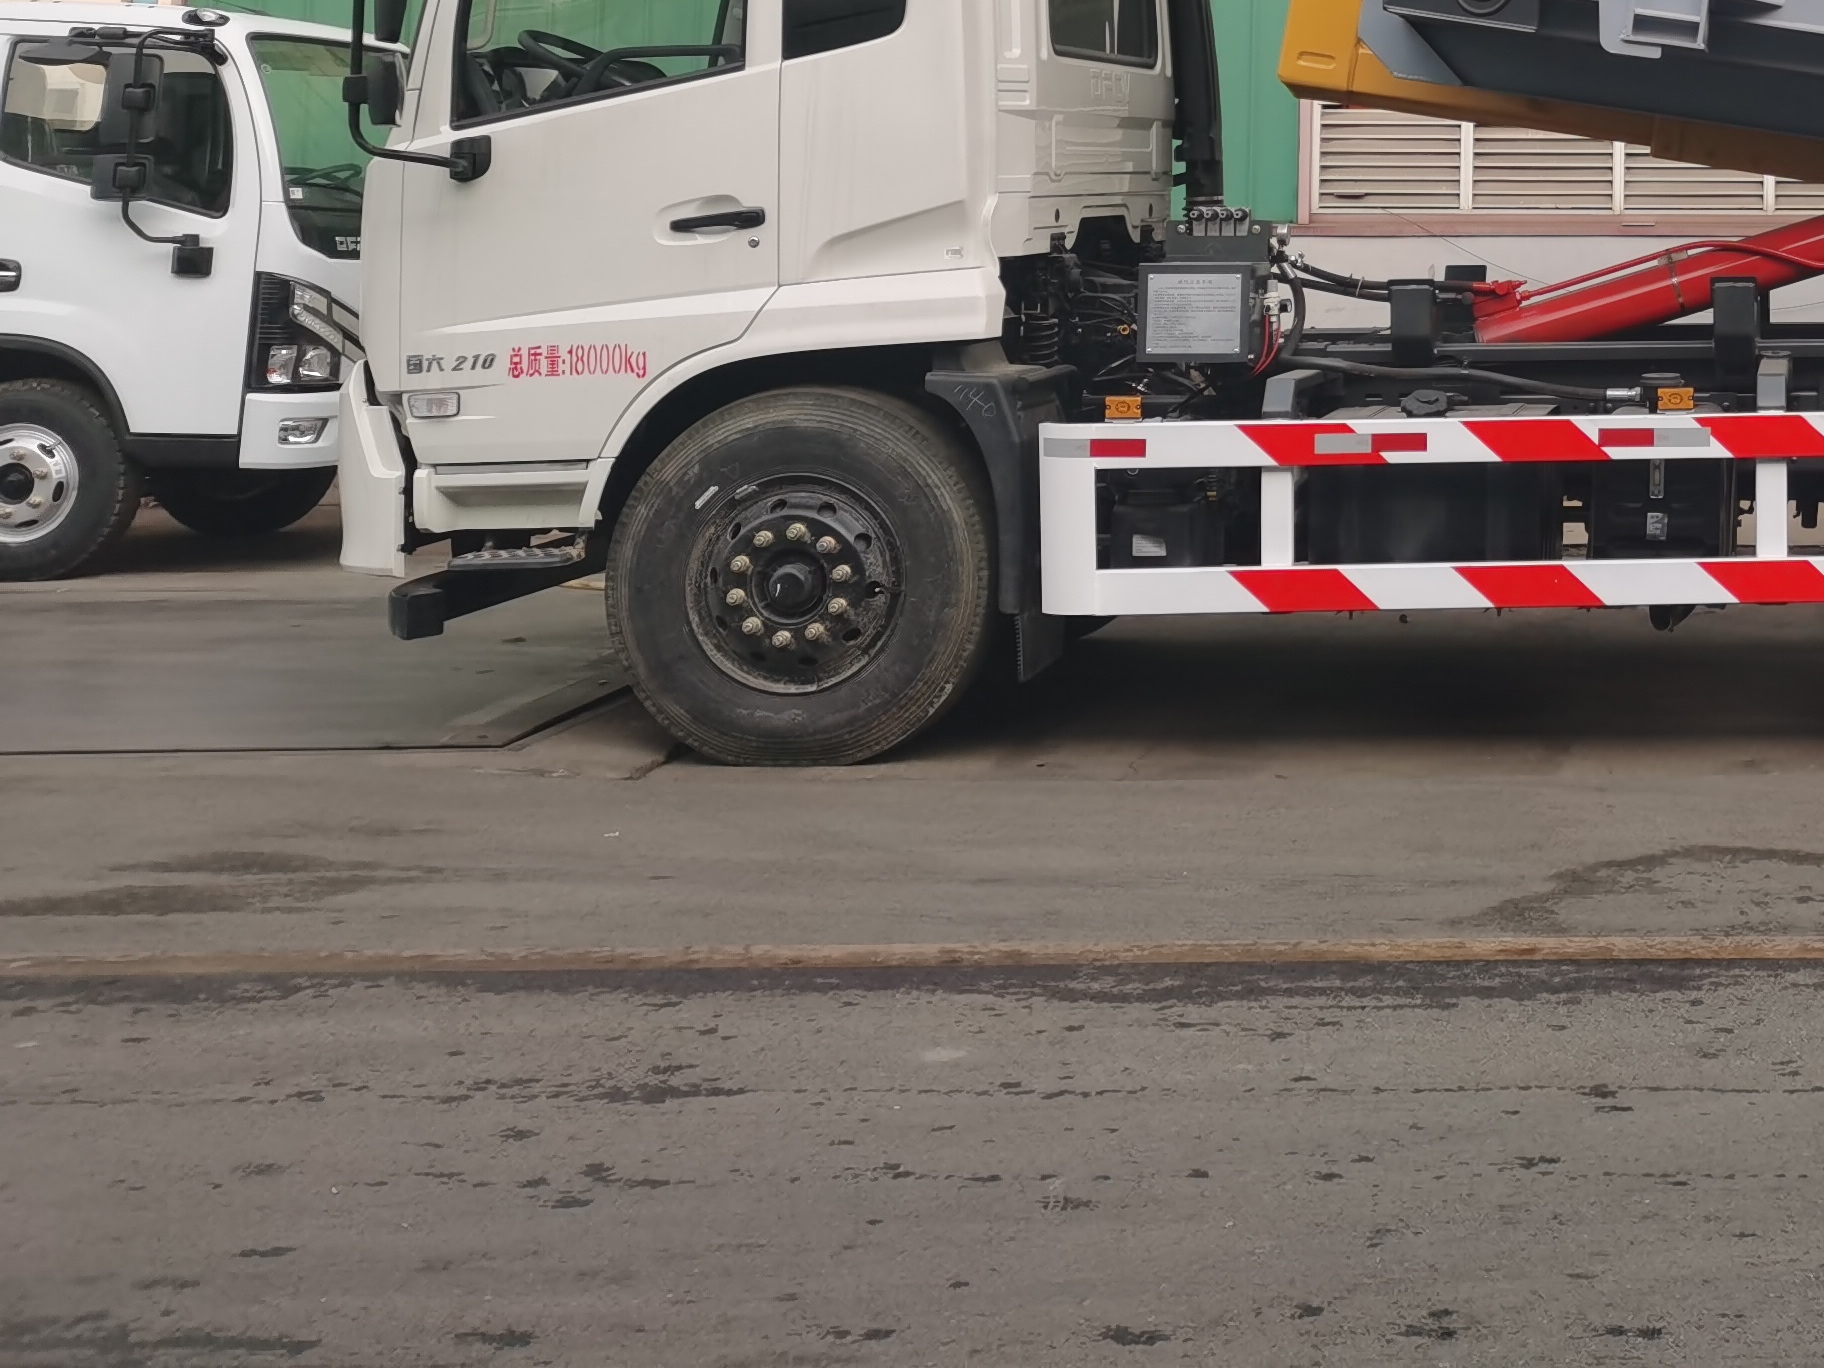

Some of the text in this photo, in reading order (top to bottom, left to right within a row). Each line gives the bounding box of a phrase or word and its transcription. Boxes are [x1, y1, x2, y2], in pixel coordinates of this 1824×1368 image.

[406, 352, 497, 374] 国六 210
[507, 343, 647, 379] 总质量:18000kg
